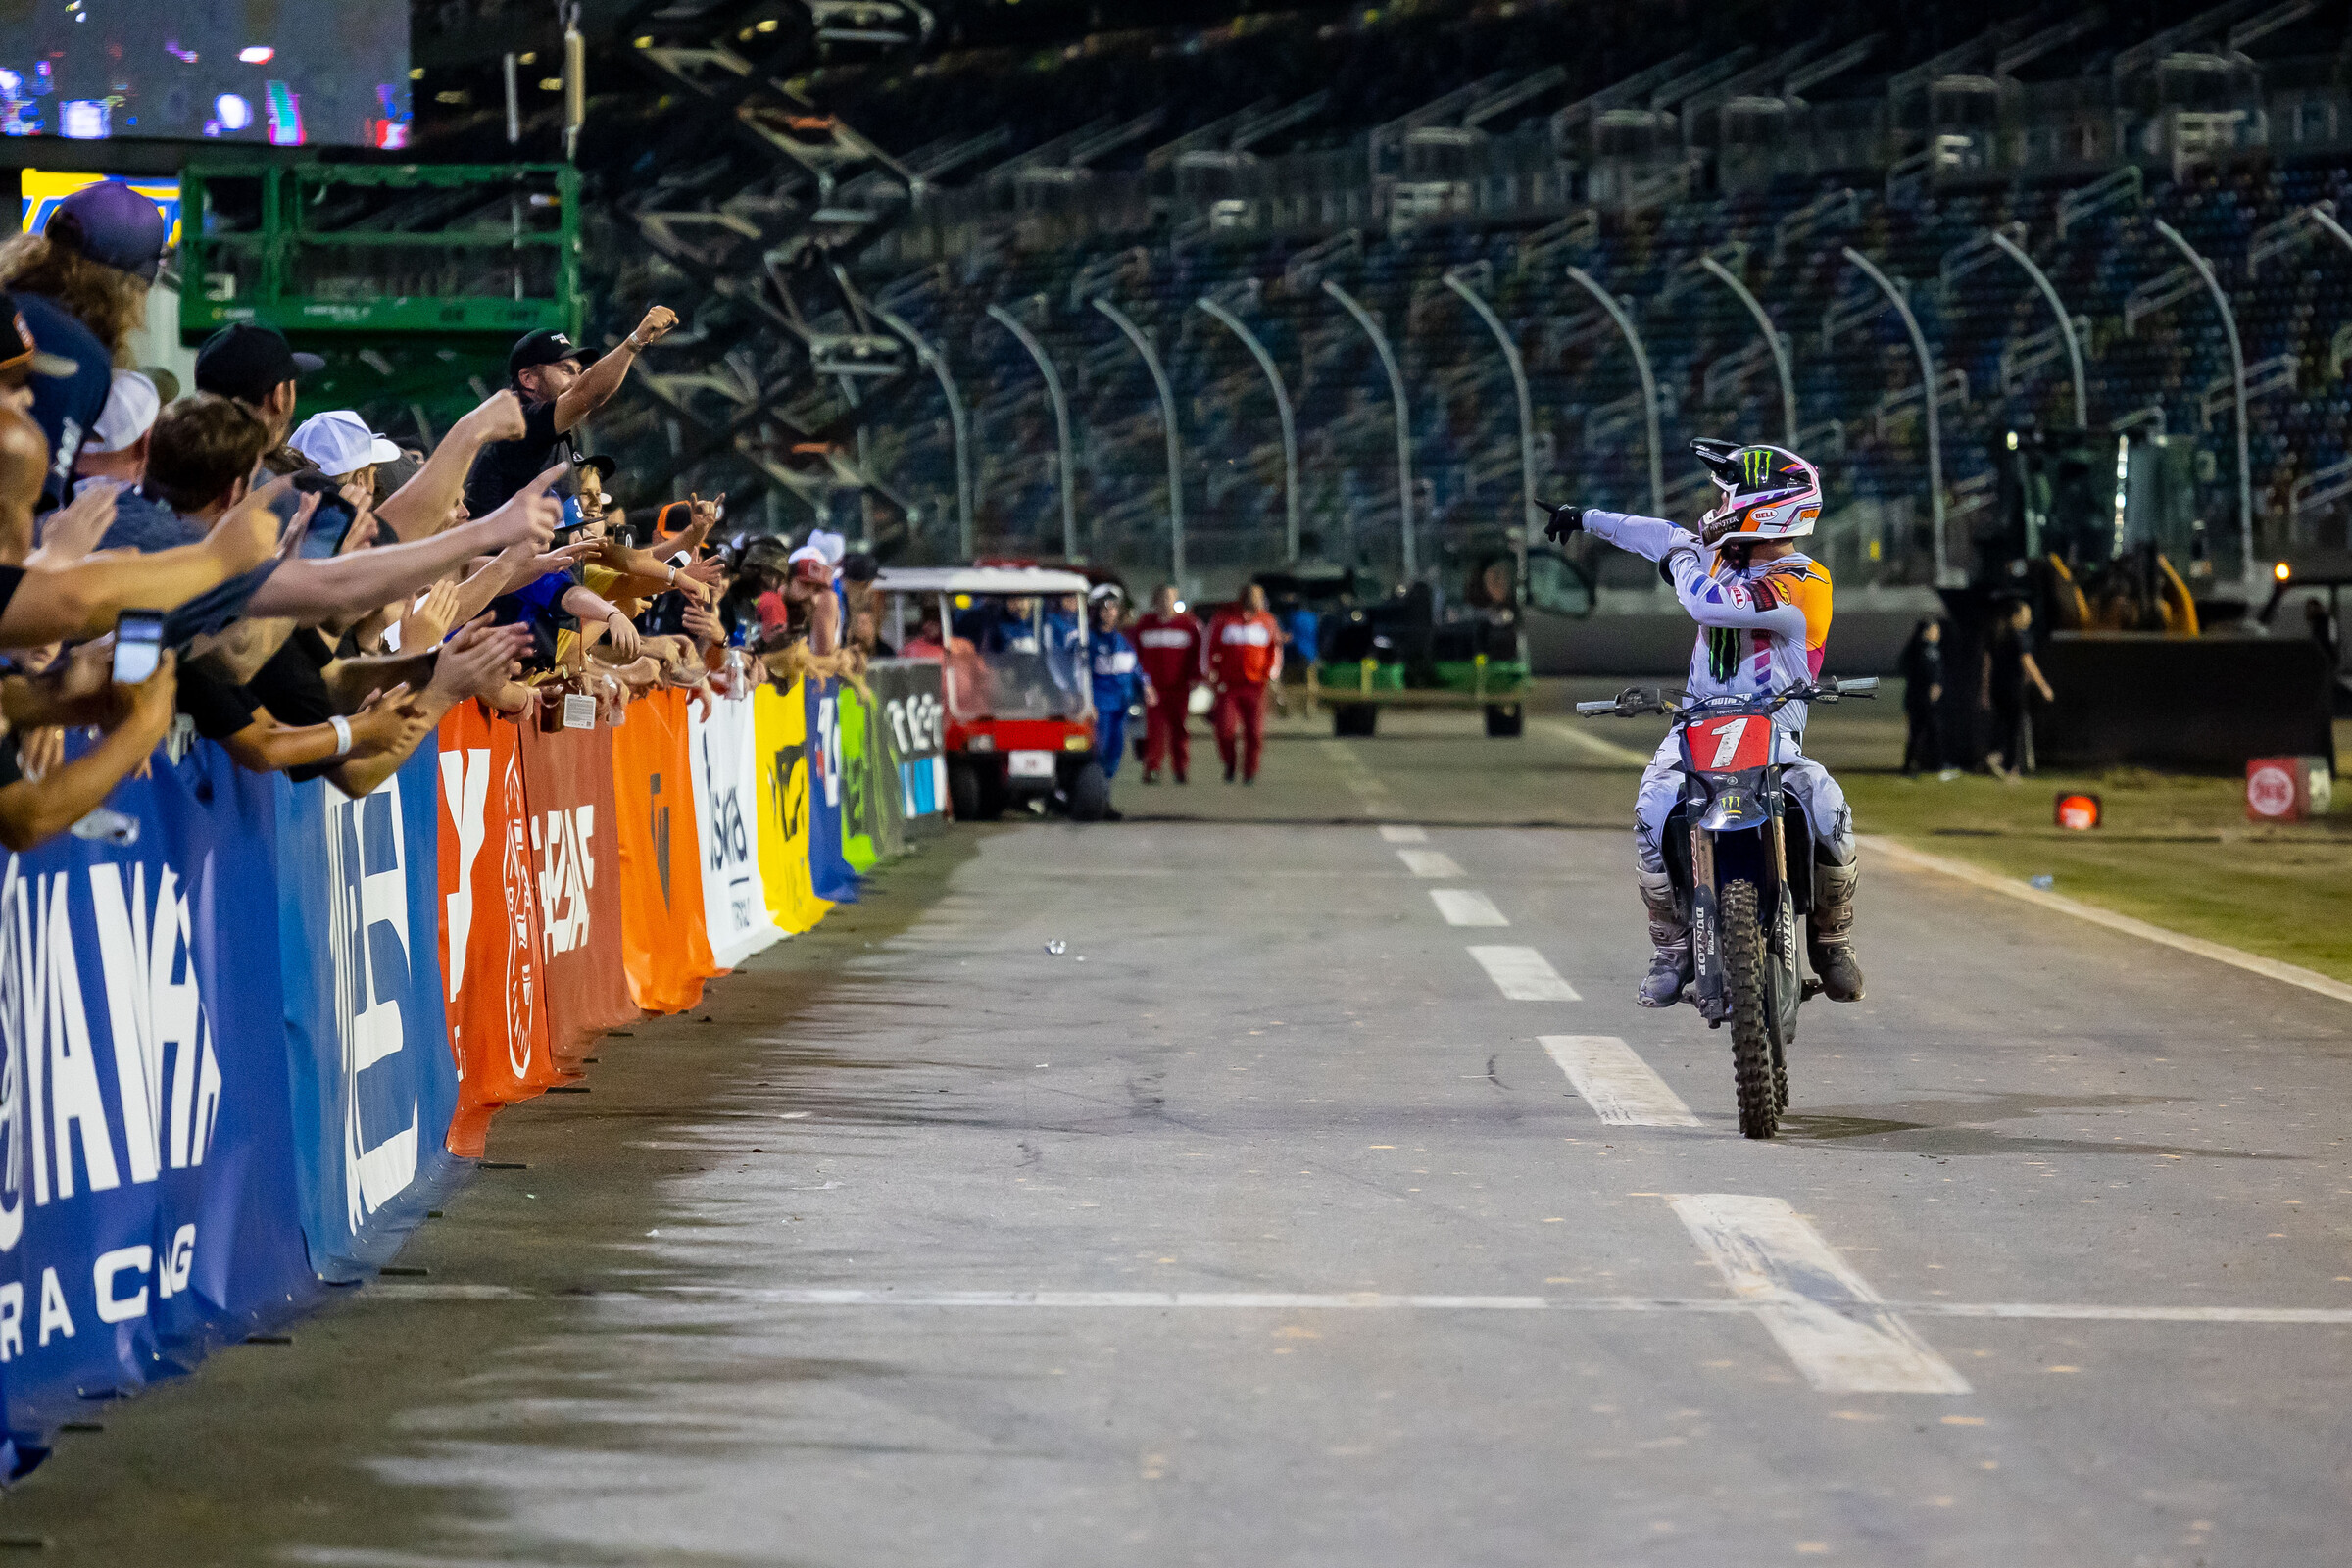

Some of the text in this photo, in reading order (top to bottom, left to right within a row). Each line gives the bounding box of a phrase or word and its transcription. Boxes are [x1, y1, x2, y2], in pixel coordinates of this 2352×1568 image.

[1709, 515, 1740, 531] MONSTER
[1755, 511, 1776, 519] BELL
[1710, 717, 1749, 769] 1
[1695, 906, 1706, 976] DUNLOP
[1782, 901, 1793, 973] DUNLOP
[0, 1223, 195, 1362] RACNG
